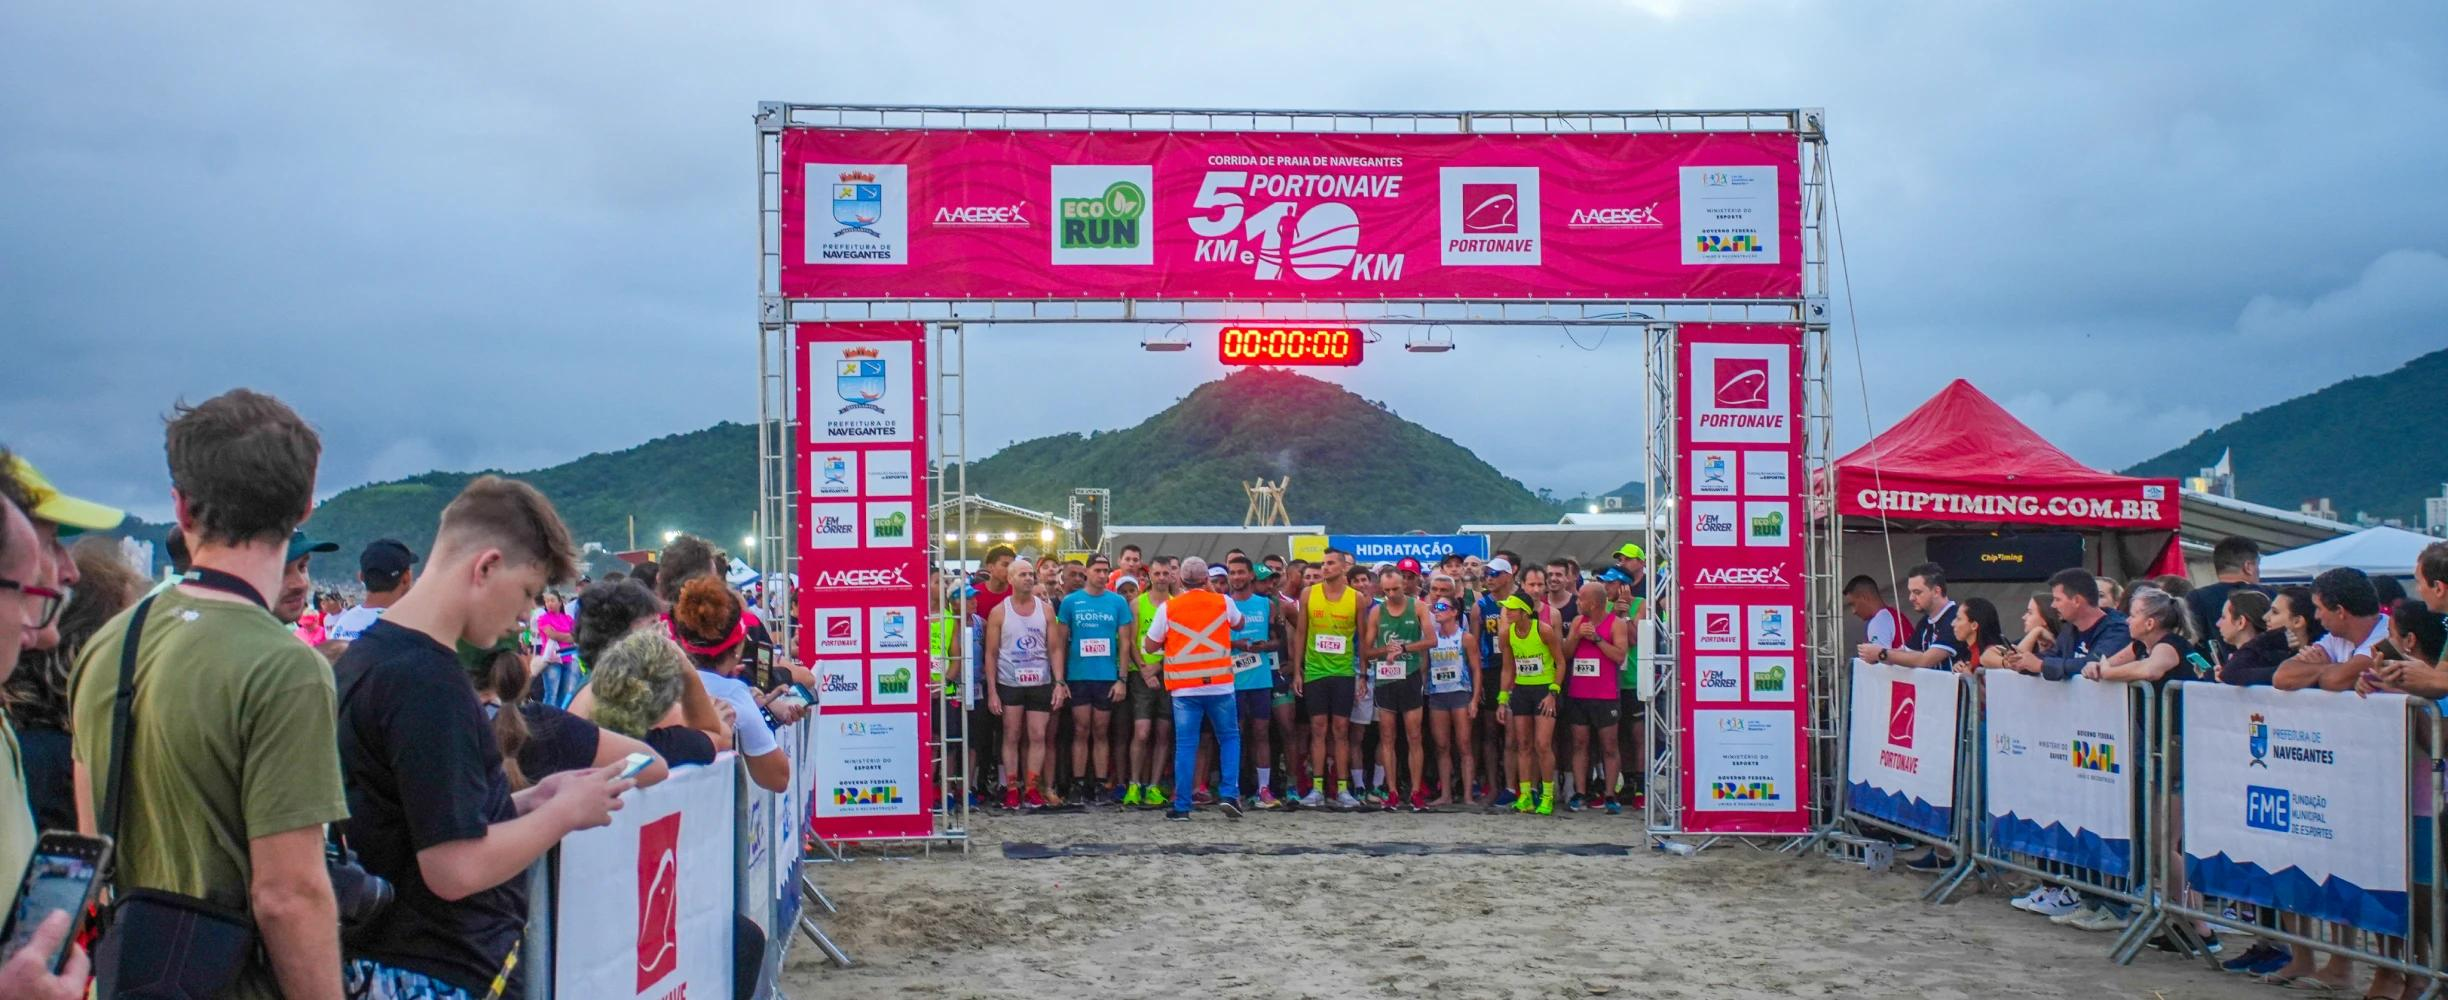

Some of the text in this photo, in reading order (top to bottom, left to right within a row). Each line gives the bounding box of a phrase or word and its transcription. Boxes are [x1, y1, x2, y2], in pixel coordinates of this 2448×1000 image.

[1208, 156, 1403, 167] CORRIDA DE PRAIA DE NAVEGANTES
[1064, 201, 1104, 217] ECO
[1187, 171, 1403, 237] 5 PORTONAVE
[1065, 219, 1136, 244] RUN
[1448, 238, 1533, 253] PORTONAVE
[1697, 235, 1763, 252] BRASIL
[823, 250, 891, 259] NAVEGANTES
[1194, 239, 1239, 262] KM
[1351, 254, 1405, 280] KM
[1223, 329, 1349, 358] 00:00:00
[1700, 414, 1783, 428] PORTONAVE
[828, 427, 896, 436] NAVEGANTES
[1857, 488, 2162, 520] CHIPTIMING.COM.BR
[818, 516, 839, 525] VEM
[1698, 514, 1719, 523] VEM
[816, 525, 853, 534] CORRER
[875, 526, 903, 537] RUN
[1696, 523, 1732, 532] CORRER
[1753, 525, 1781, 536] RUN
[1356, 541, 1453, 558] HIDRATAÇÃO
[821, 639, 858, 647] PORTONAVE
[823, 674, 844, 683] VEM
[1702, 670, 1723, 679] VEM
[821, 682, 858, 691] CORRER
[879, 682, 909, 694] RUN
[1700, 679, 1737, 688] CORRER
[1755, 680, 1783, 690] RUN
[2273, 728, 2321, 743] PREFEITURA DE
[1879, 749, 1919, 775] PORTONAVE
[2072, 740, 2120, 774] BRASIL
[2273, 745, 2334, 765] NAVEGANTES
[833, 786, 903, 805] BRASIL
[1712, 782, 1780, 800] BRASIL
[2292, 794, 2327, 809] FUNDAÇÃO
[2249, 792, 2287, 827] FME
[2292, 809, 2326, 824] MUNICIPAL
[2292, 823, 2333, 839] DE ESPORTES
